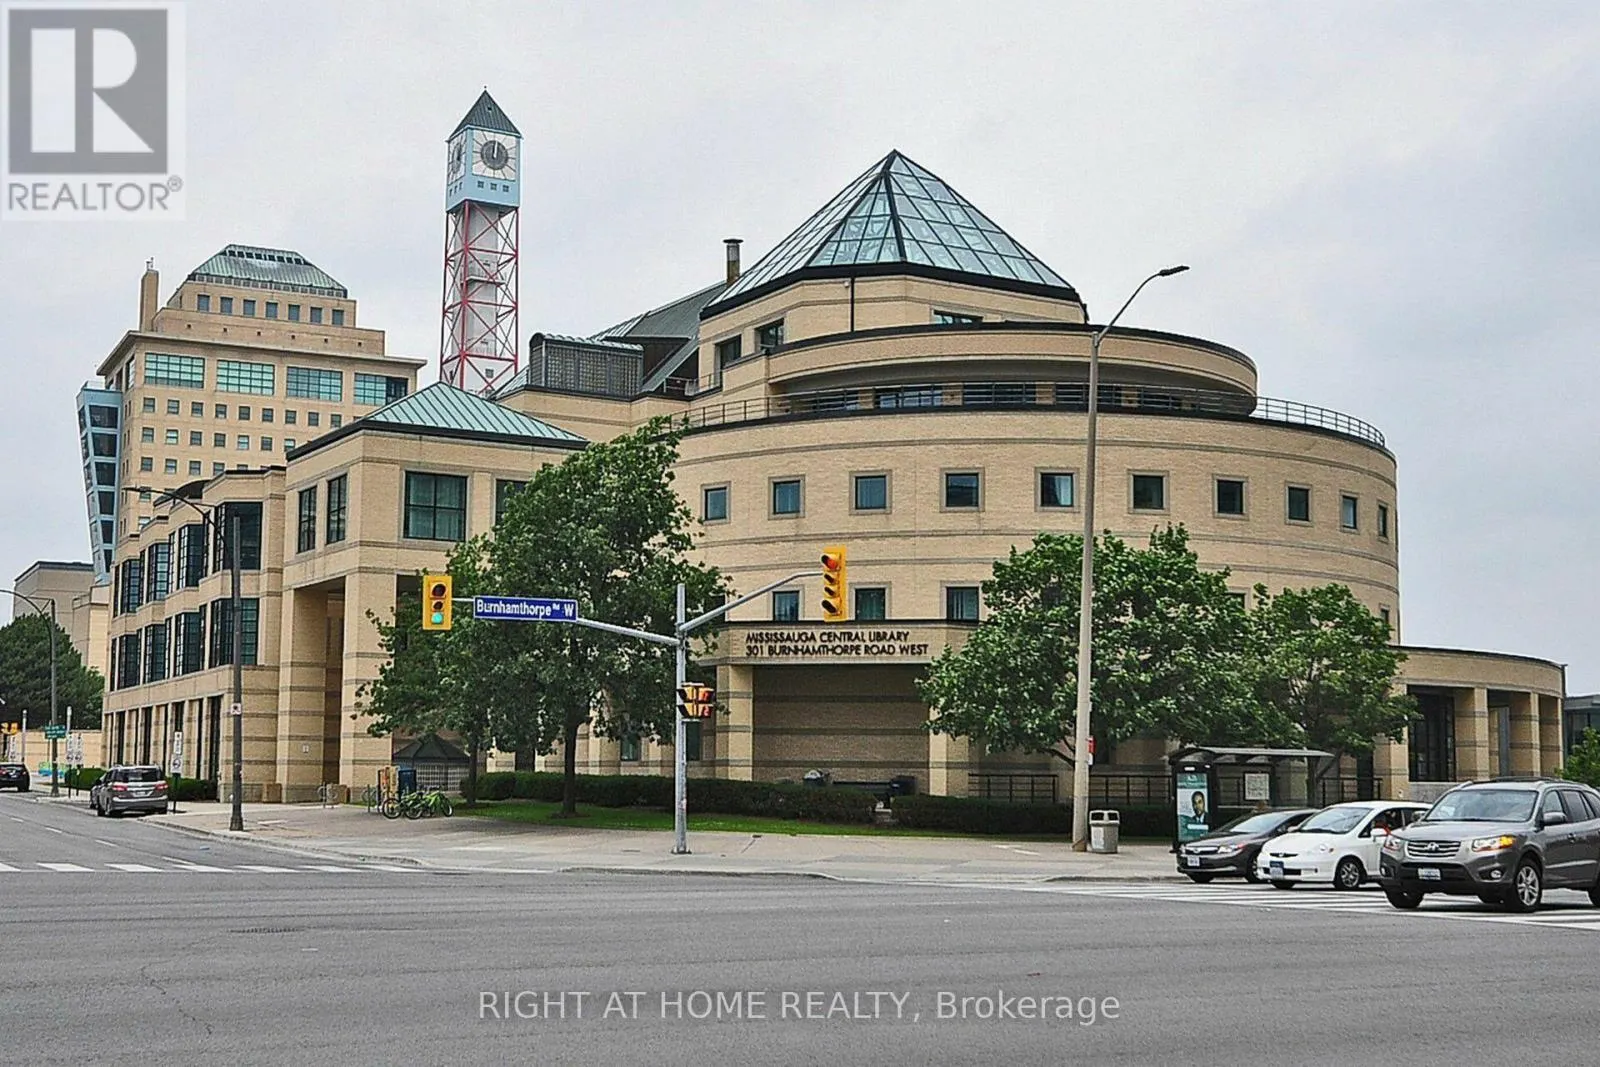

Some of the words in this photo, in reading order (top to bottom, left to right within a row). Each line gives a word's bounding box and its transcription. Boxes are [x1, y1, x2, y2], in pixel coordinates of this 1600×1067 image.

[477, 599, 552, 619] Burnhamthorpe
[564, 603, 574, 617] W
[746, 631, 817, 643] MISSISSAUGA
[819, 631, 866, 643] CENTRAL
[869, 631, 910, 643] LIBRARY
[746, 645, 764, 656] 301
[768, 645, 862, 656] BURNHAMTHORPE
[864, 644, 896, 655] ROAD
[899, 644, 929, 655] WEST
